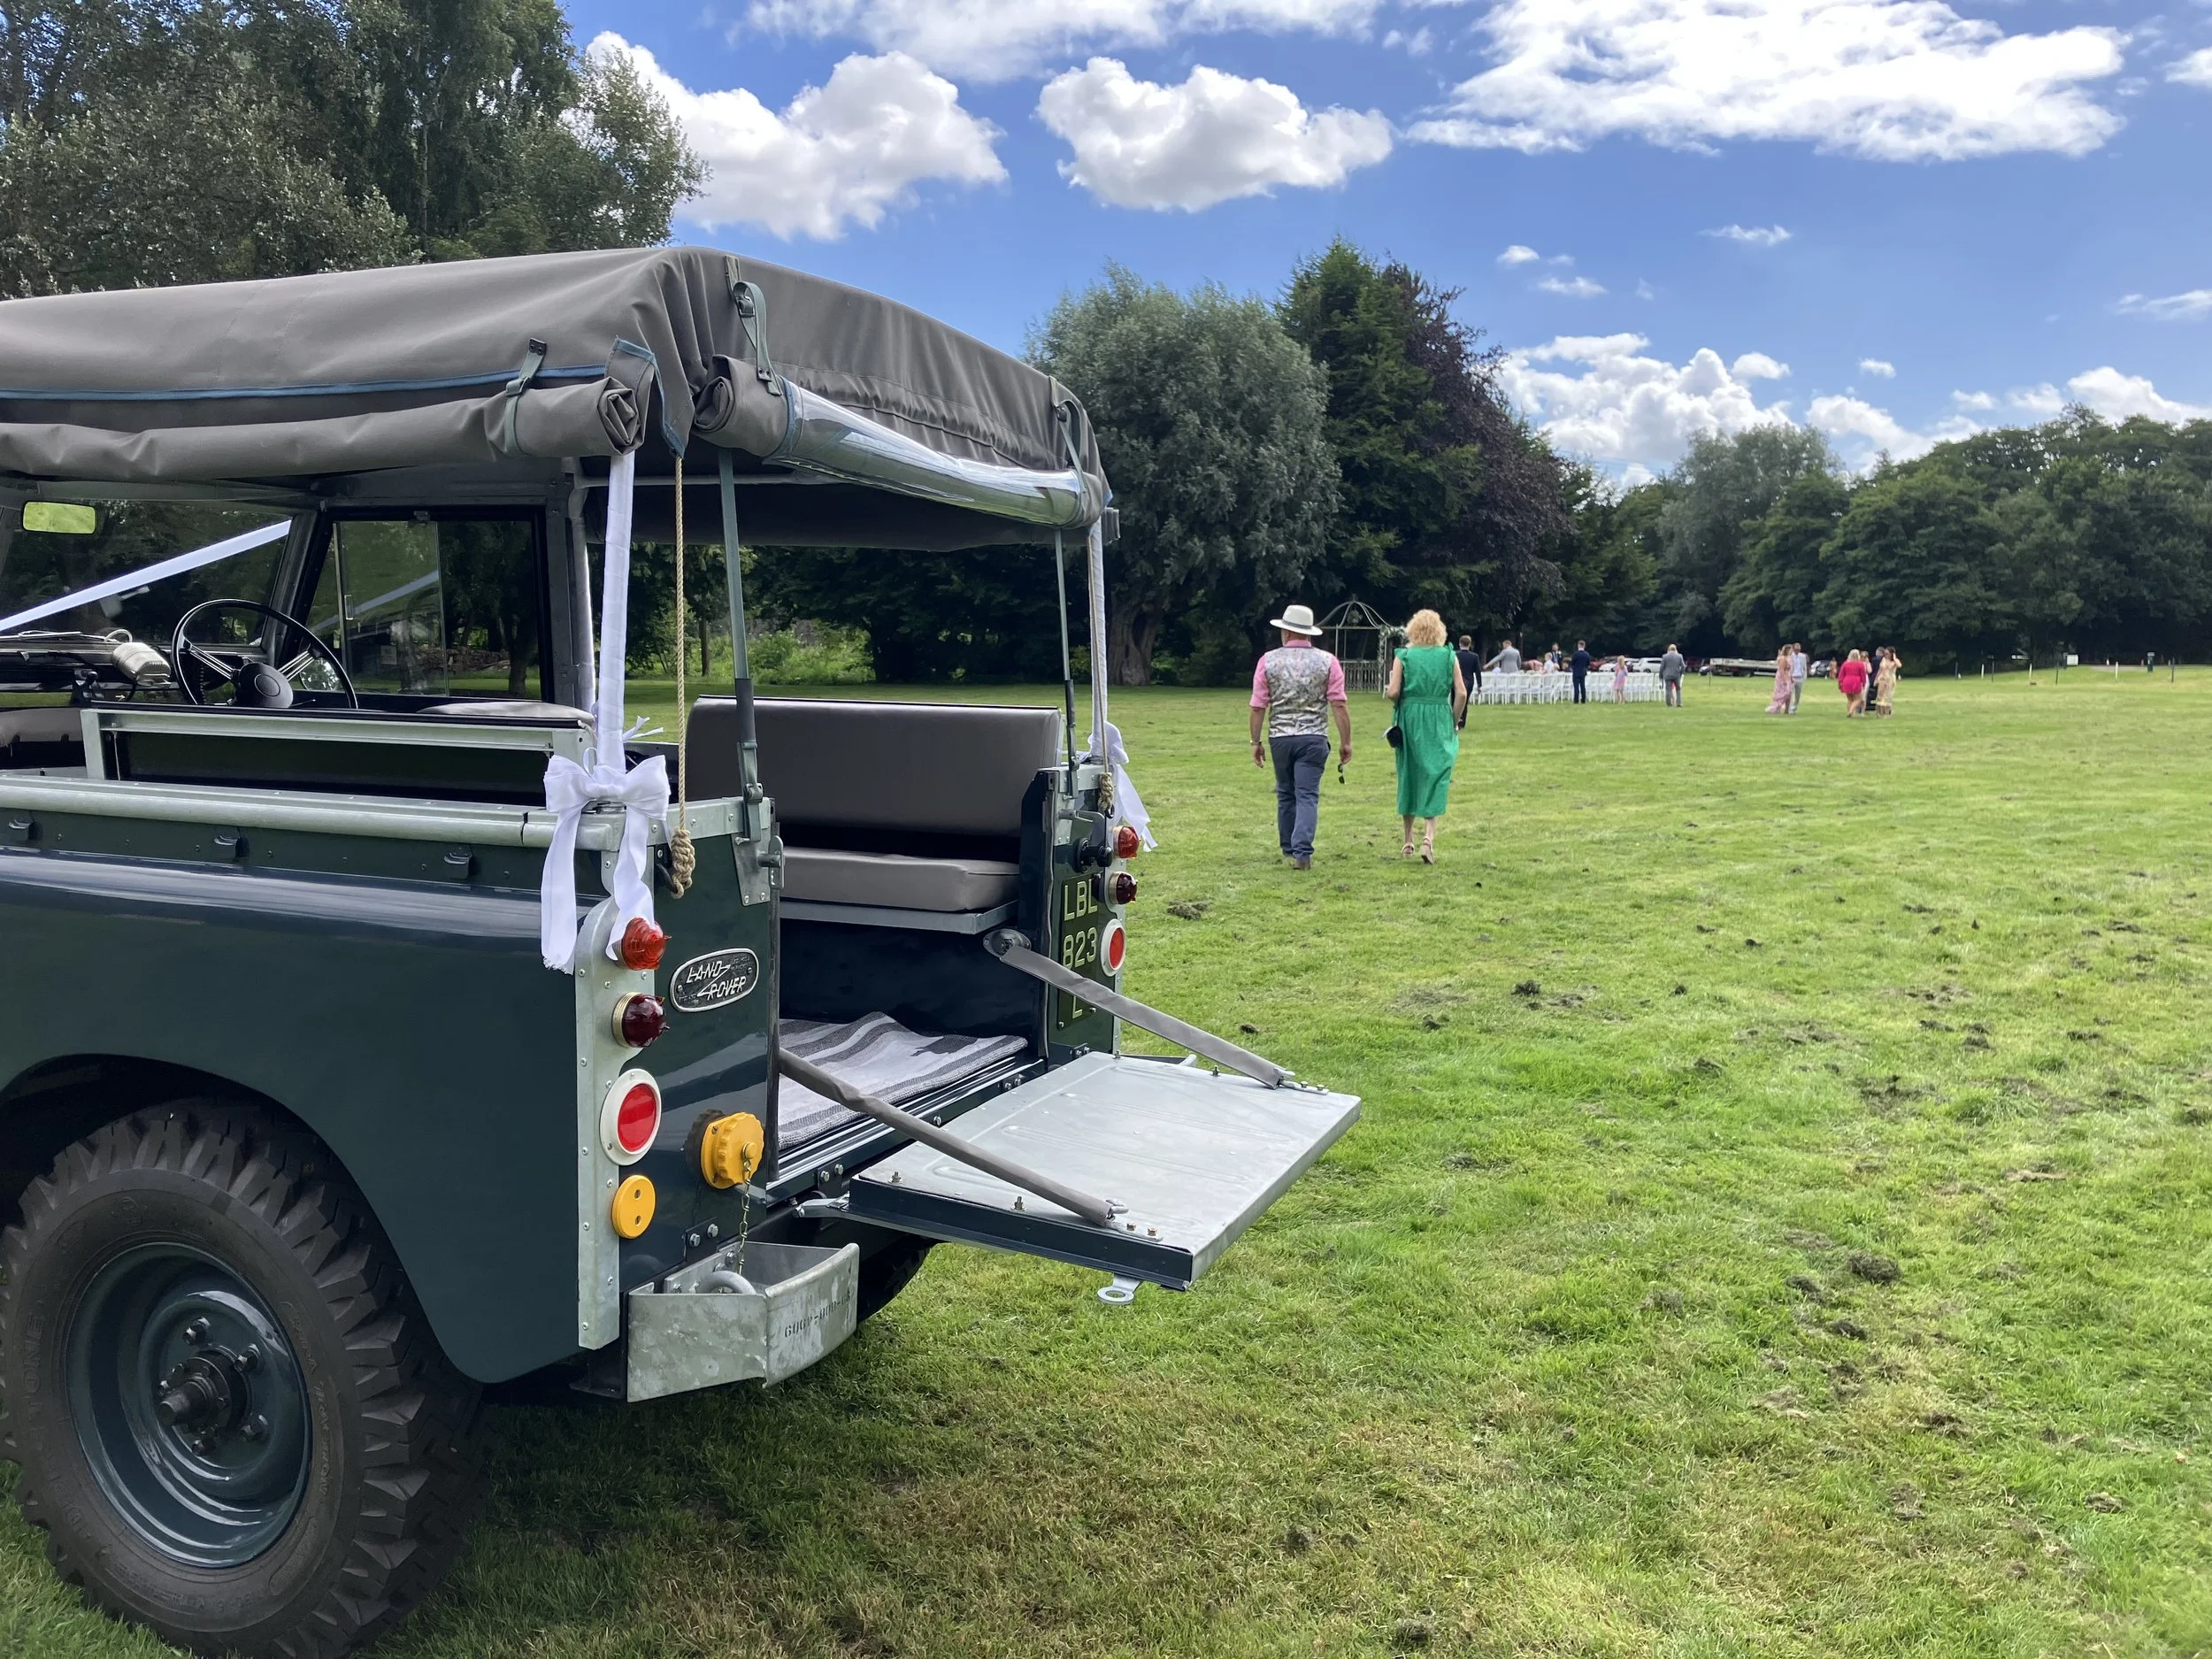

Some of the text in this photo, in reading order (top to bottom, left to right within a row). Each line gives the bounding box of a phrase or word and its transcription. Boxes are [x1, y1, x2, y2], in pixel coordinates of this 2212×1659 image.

[1064, 879, 1098, 921] LBL
[1063, 926, 1098, 971] 823
[686, 961, 723, 984] LAND
[707, 976, 747, 1001] ROVER
